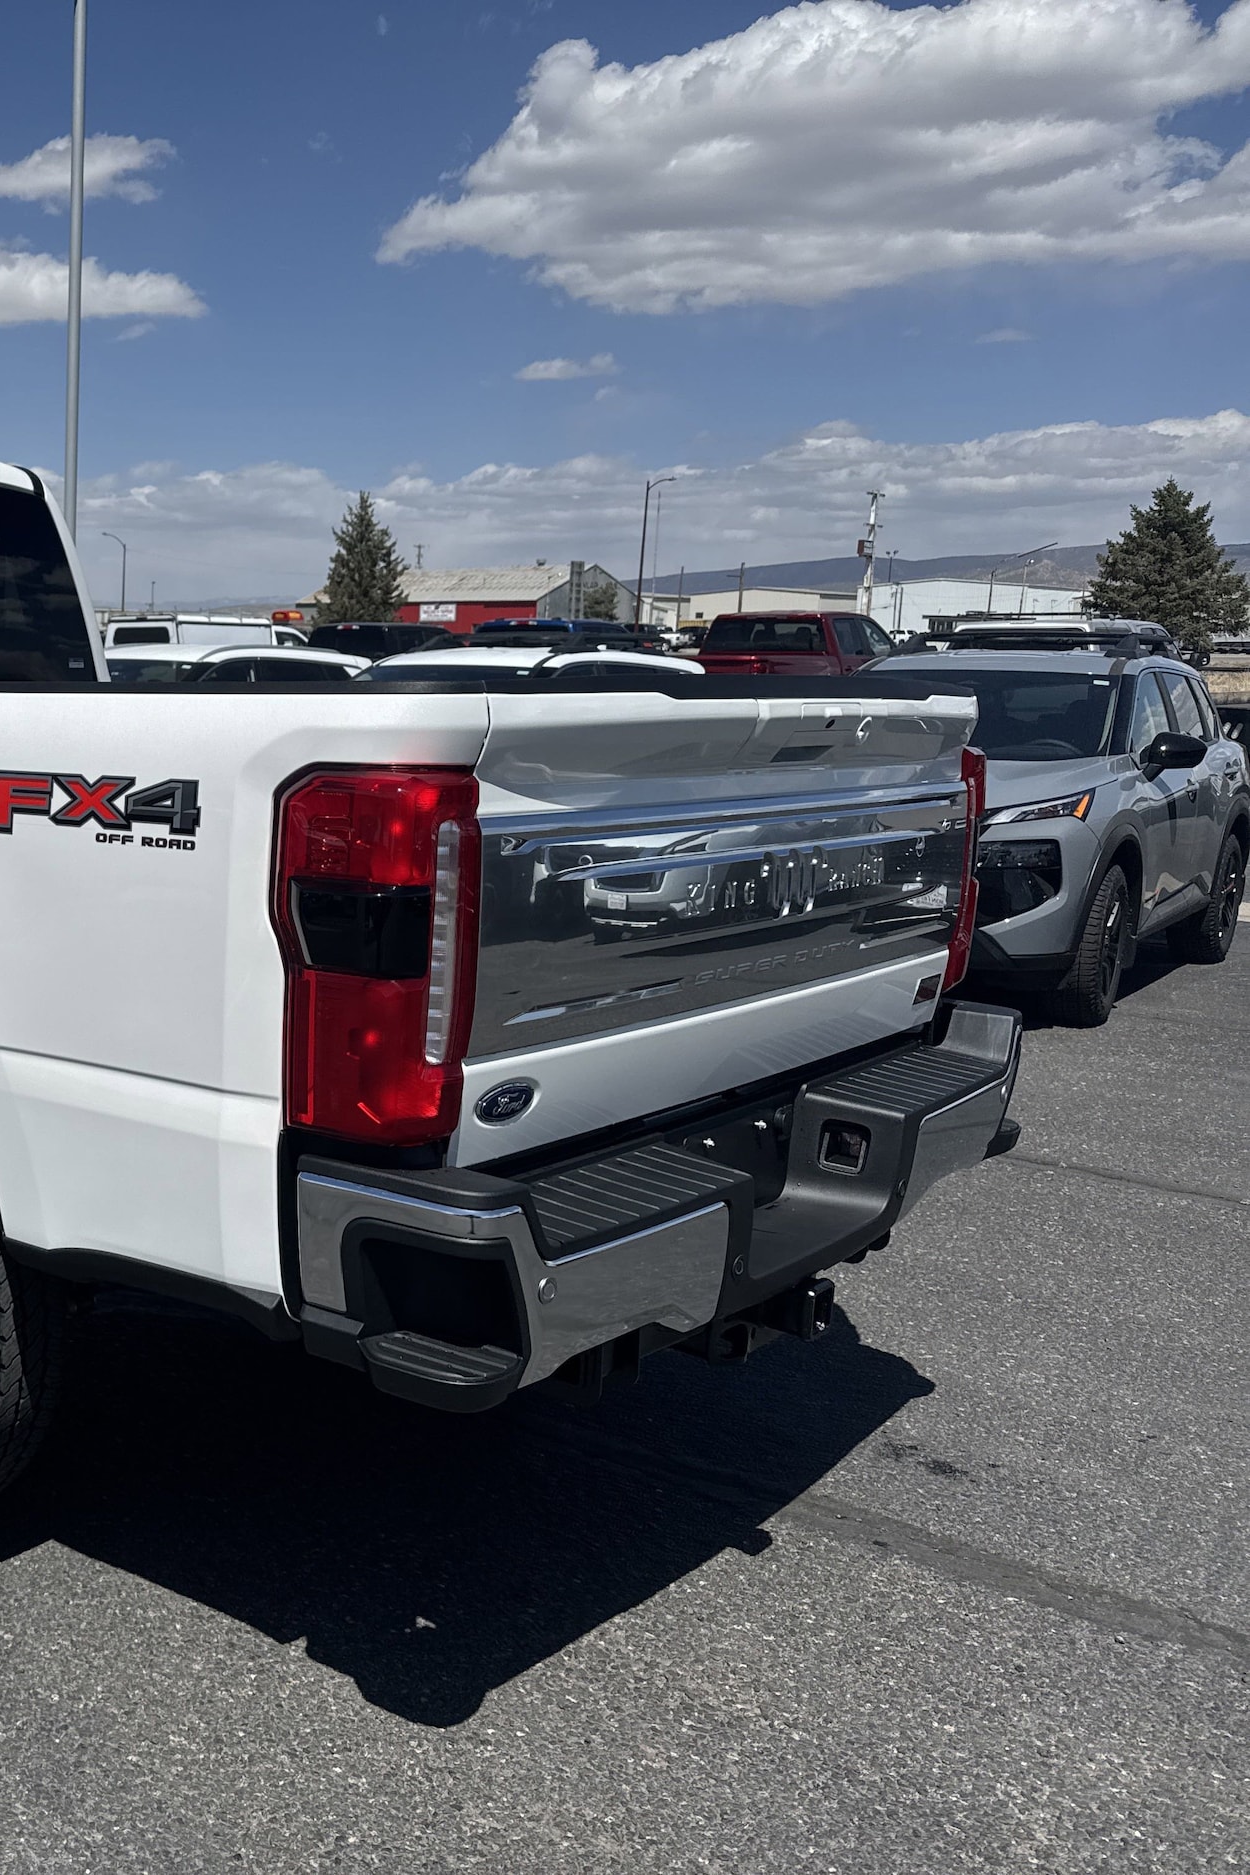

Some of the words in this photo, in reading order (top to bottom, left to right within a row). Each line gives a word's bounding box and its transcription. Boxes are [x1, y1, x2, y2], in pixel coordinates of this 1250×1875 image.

[95, 832, 134, 845] OFF
[141, 836, 196, 851] ROAD
[682, 879, 756, 917] KING
[695, 954, 787, 985] SUPER
[795, 939, 854, 965] DUTY
